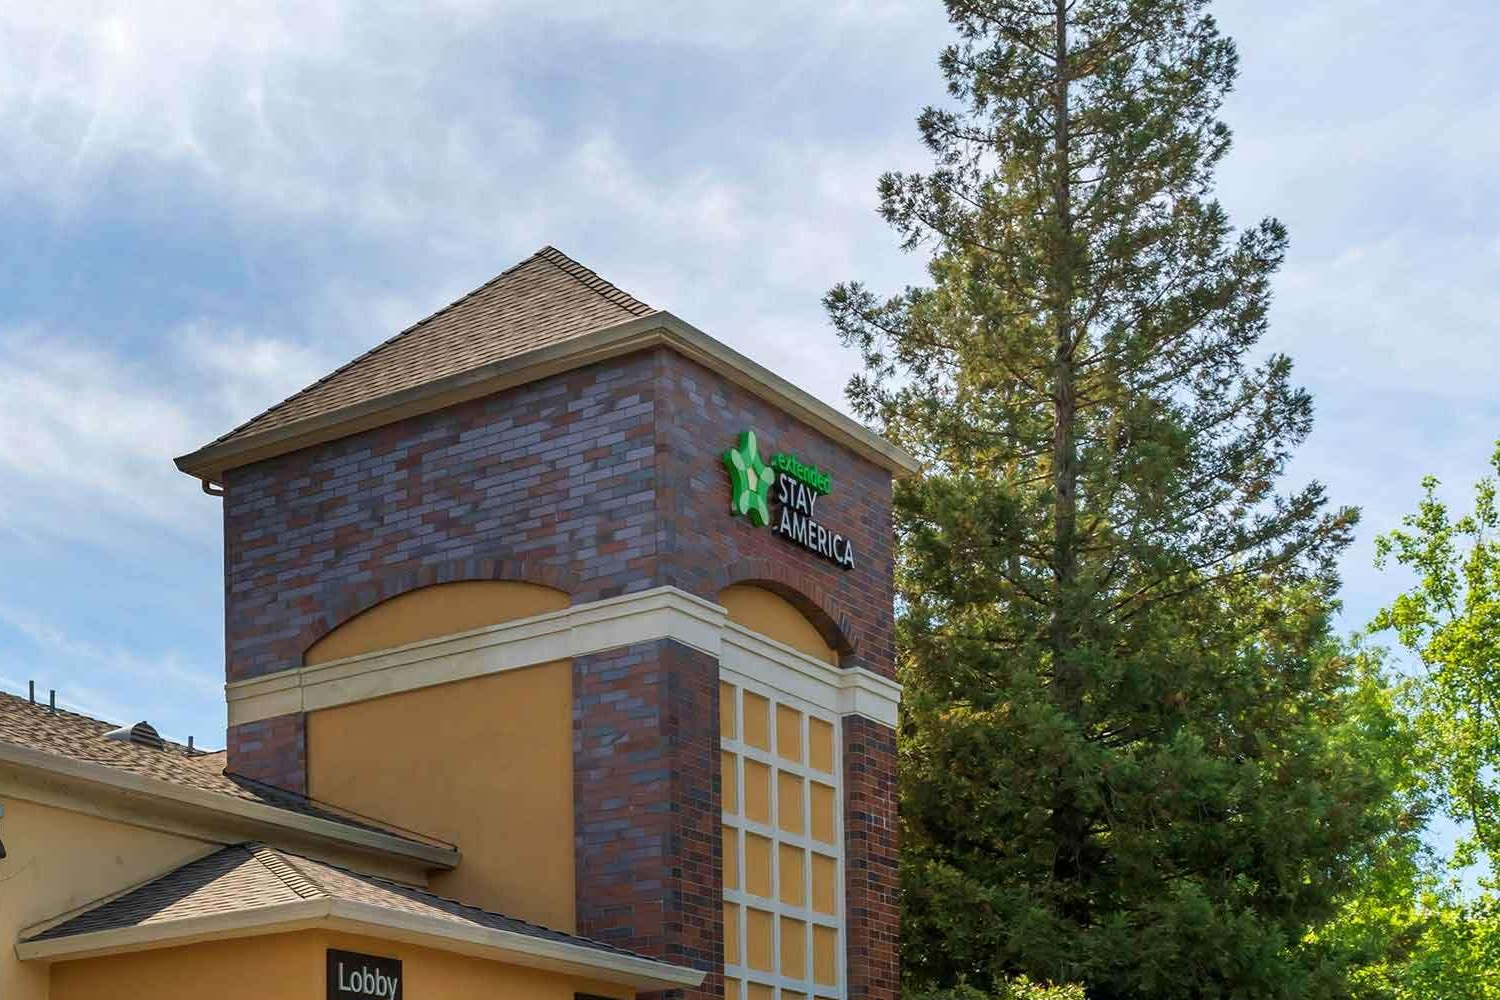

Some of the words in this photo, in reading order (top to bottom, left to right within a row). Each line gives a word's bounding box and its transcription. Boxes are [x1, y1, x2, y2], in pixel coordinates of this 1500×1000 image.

[778, 453, 831, 492] extended
[778, 473, 818, 517] STAY
[779, 507, 856, 569] AMERICA
